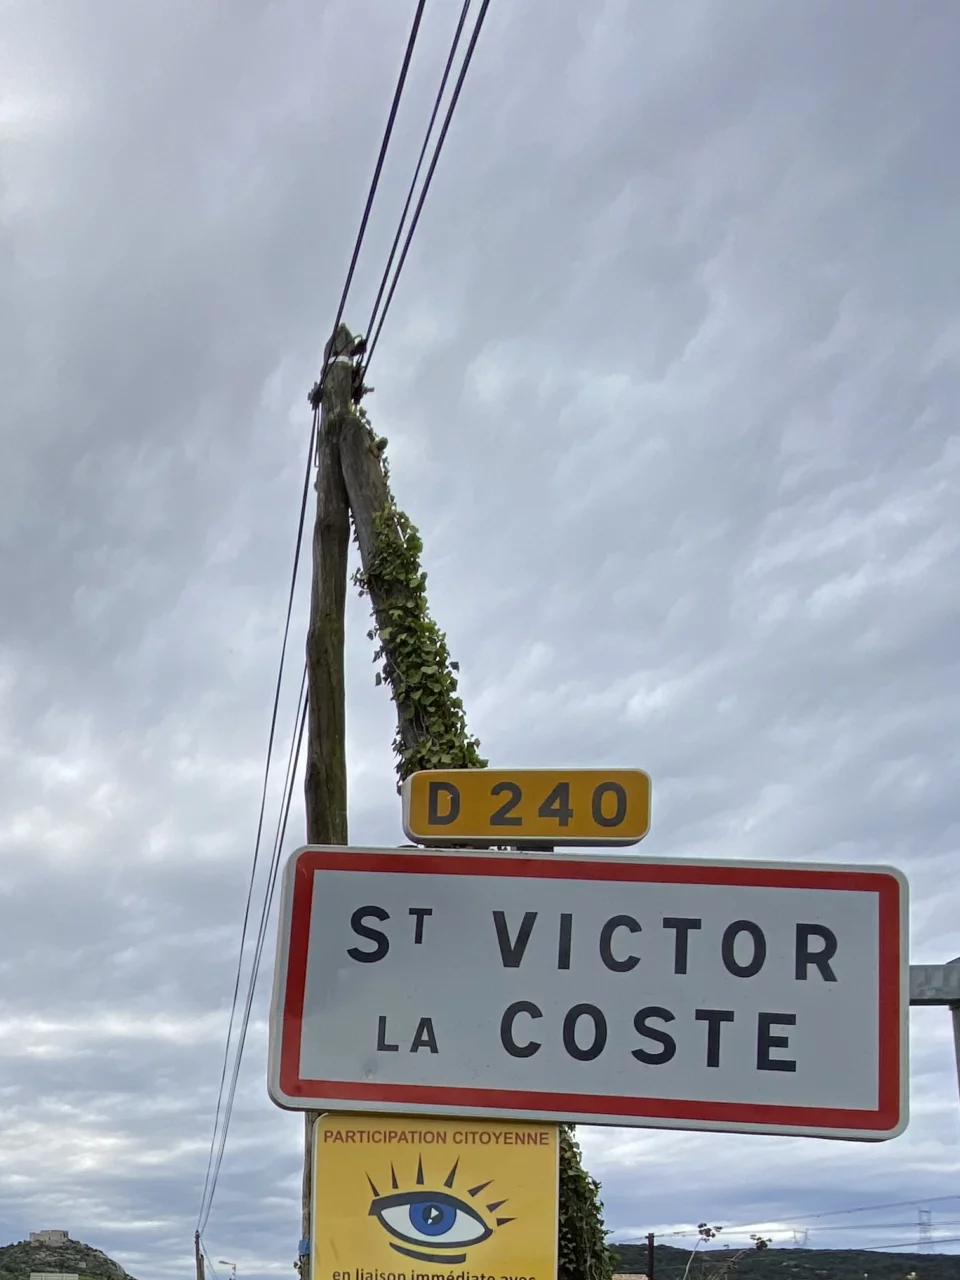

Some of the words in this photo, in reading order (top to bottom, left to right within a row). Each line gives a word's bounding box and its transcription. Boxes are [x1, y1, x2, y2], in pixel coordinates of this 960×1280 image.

[427, 782, 461, 826] D
[490, 781, 628, 828] 240
[492, 911, 838, 982] VICTOR
[376, 1015, 439, 1054] LA
[500, 1000, 797, 1073] COSTE
[324, 1130, 447, 1145] PARTICIPATION
[452, 1131, 549, 1145] CITOYENNE
